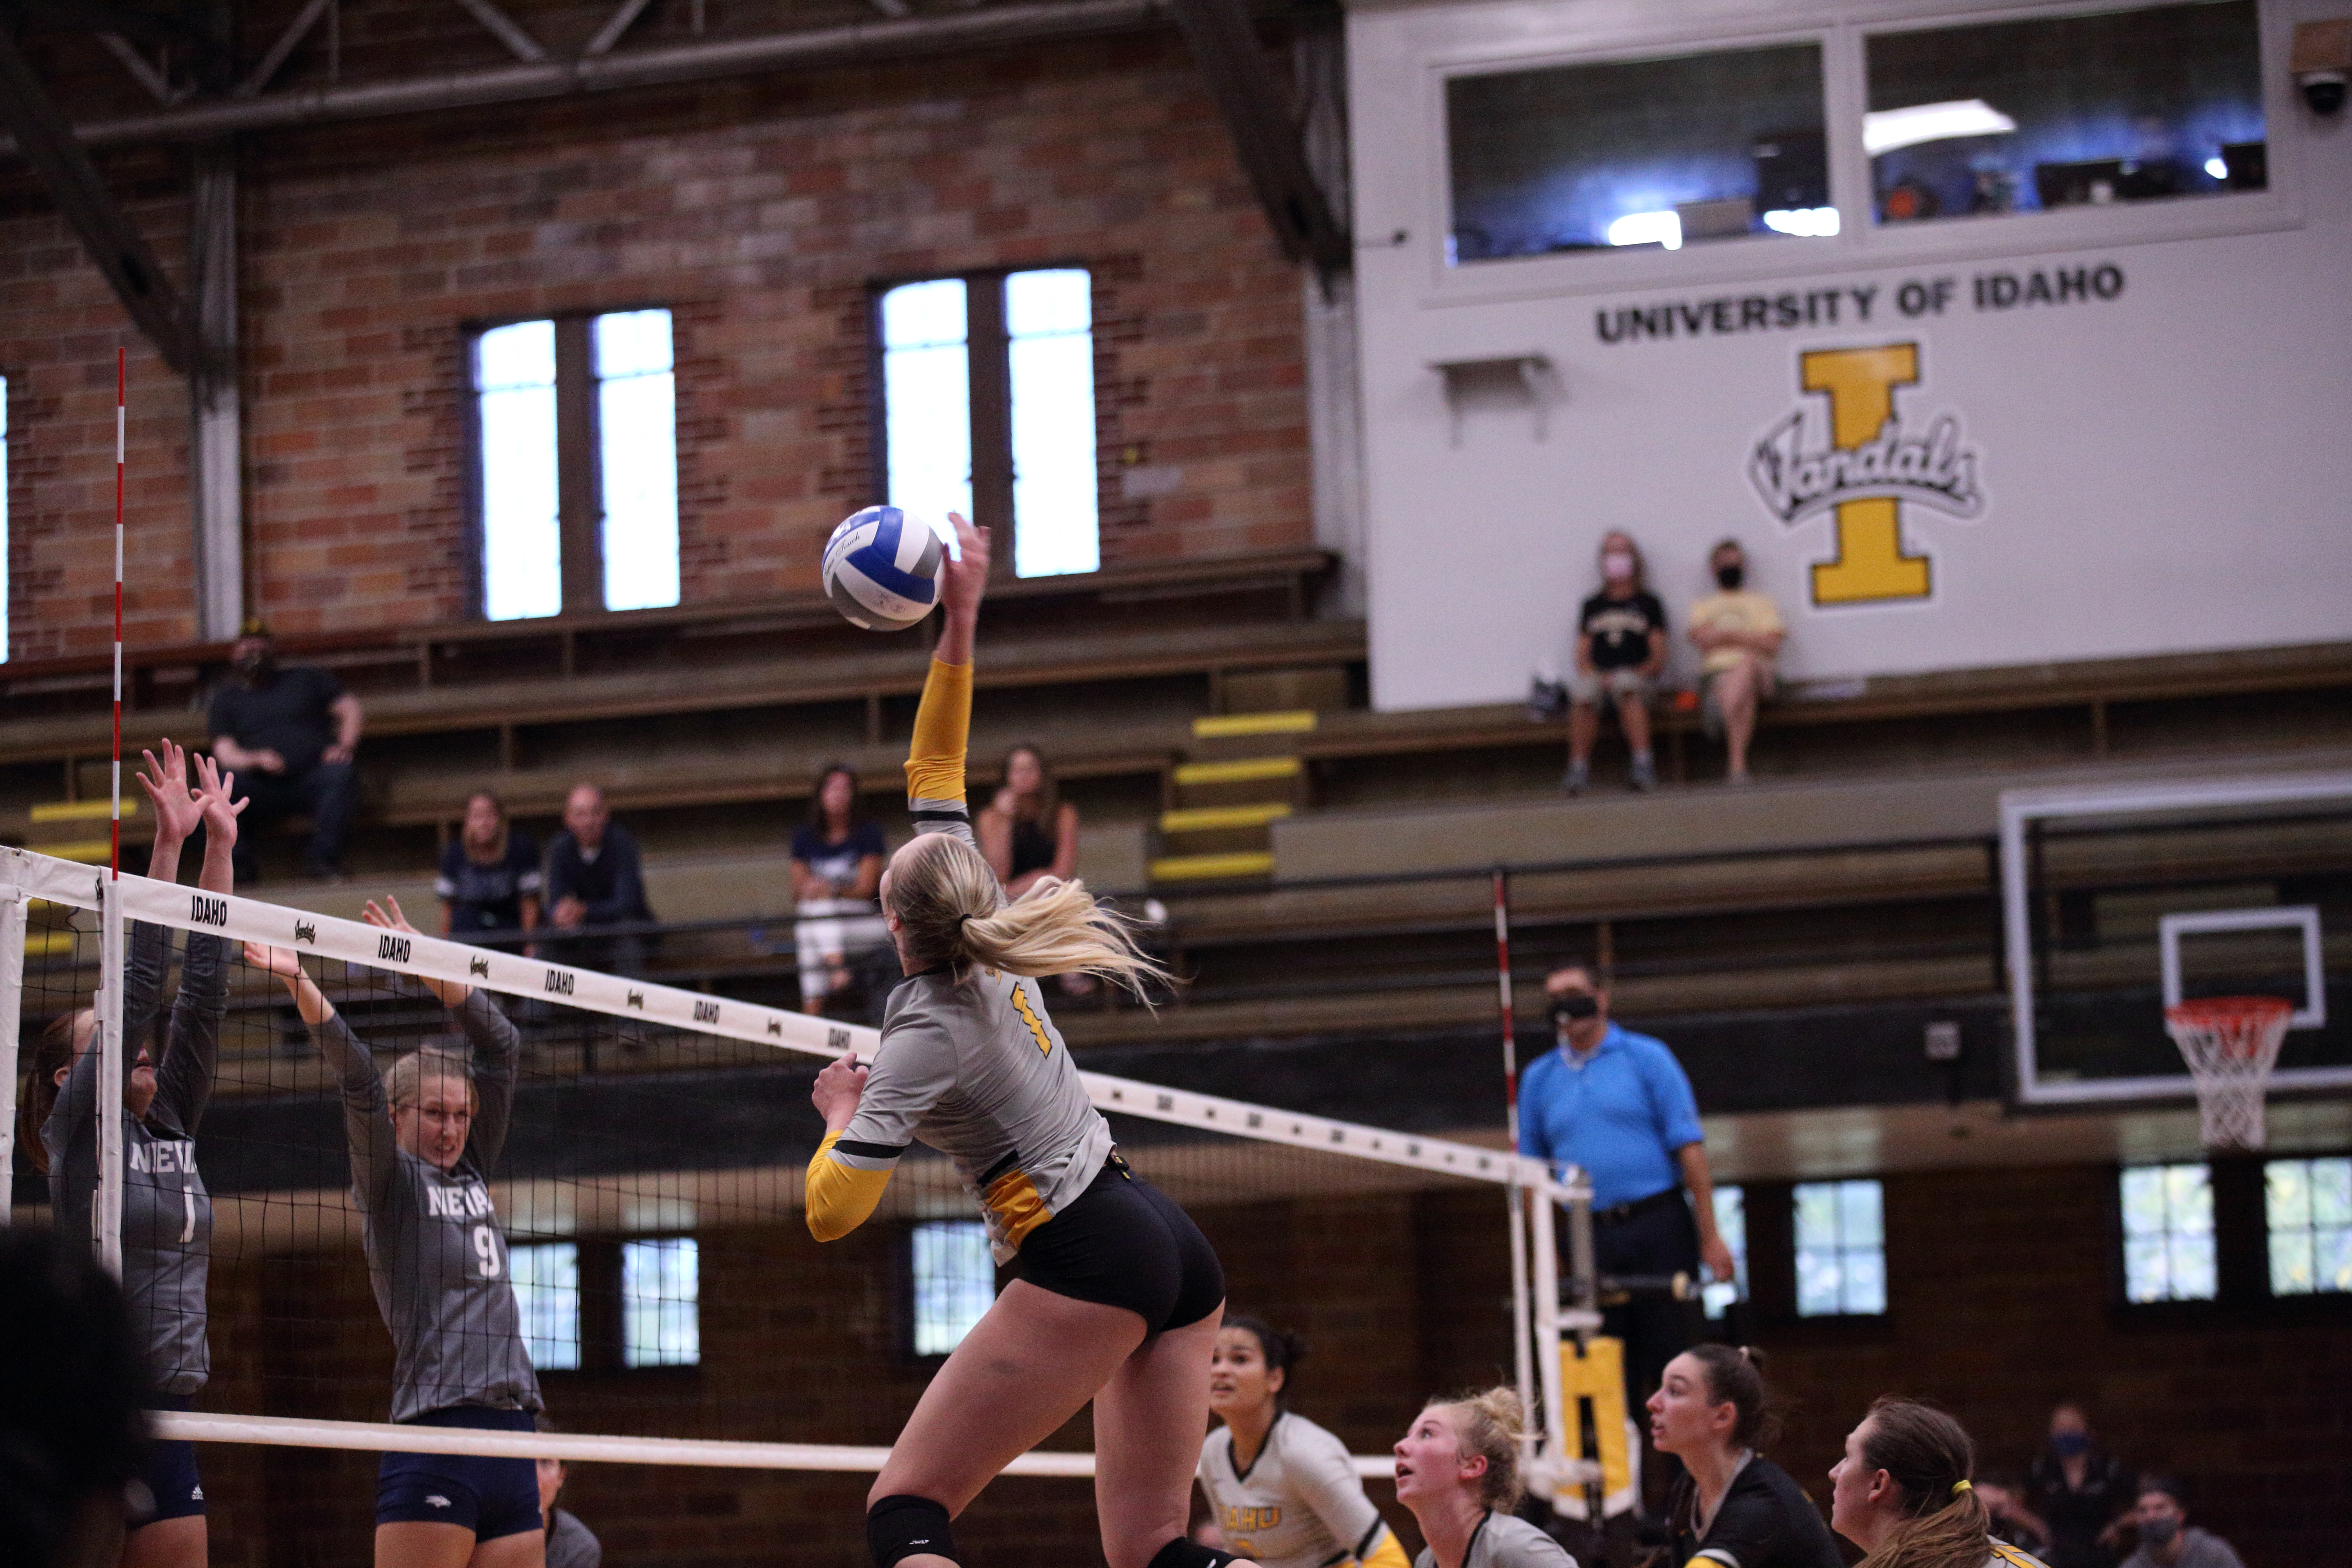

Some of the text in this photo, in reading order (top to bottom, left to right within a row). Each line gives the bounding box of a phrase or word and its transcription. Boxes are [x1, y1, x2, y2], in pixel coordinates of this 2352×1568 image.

[1596, 262, 2125, 344] UNIVERSITY OF IDAHO
[1750, 410, 1984, 526] Vandals
[191, 895, 227, 927] IDAHO
[378, 935, 411, 963] IDAHO
[545, 969, 574, 996] IDAHO
[694, 1000, 720, 1024] IDAHO
[178, 1185, 196, 1243] 1
[474, 1225, 501, 1276] 9
